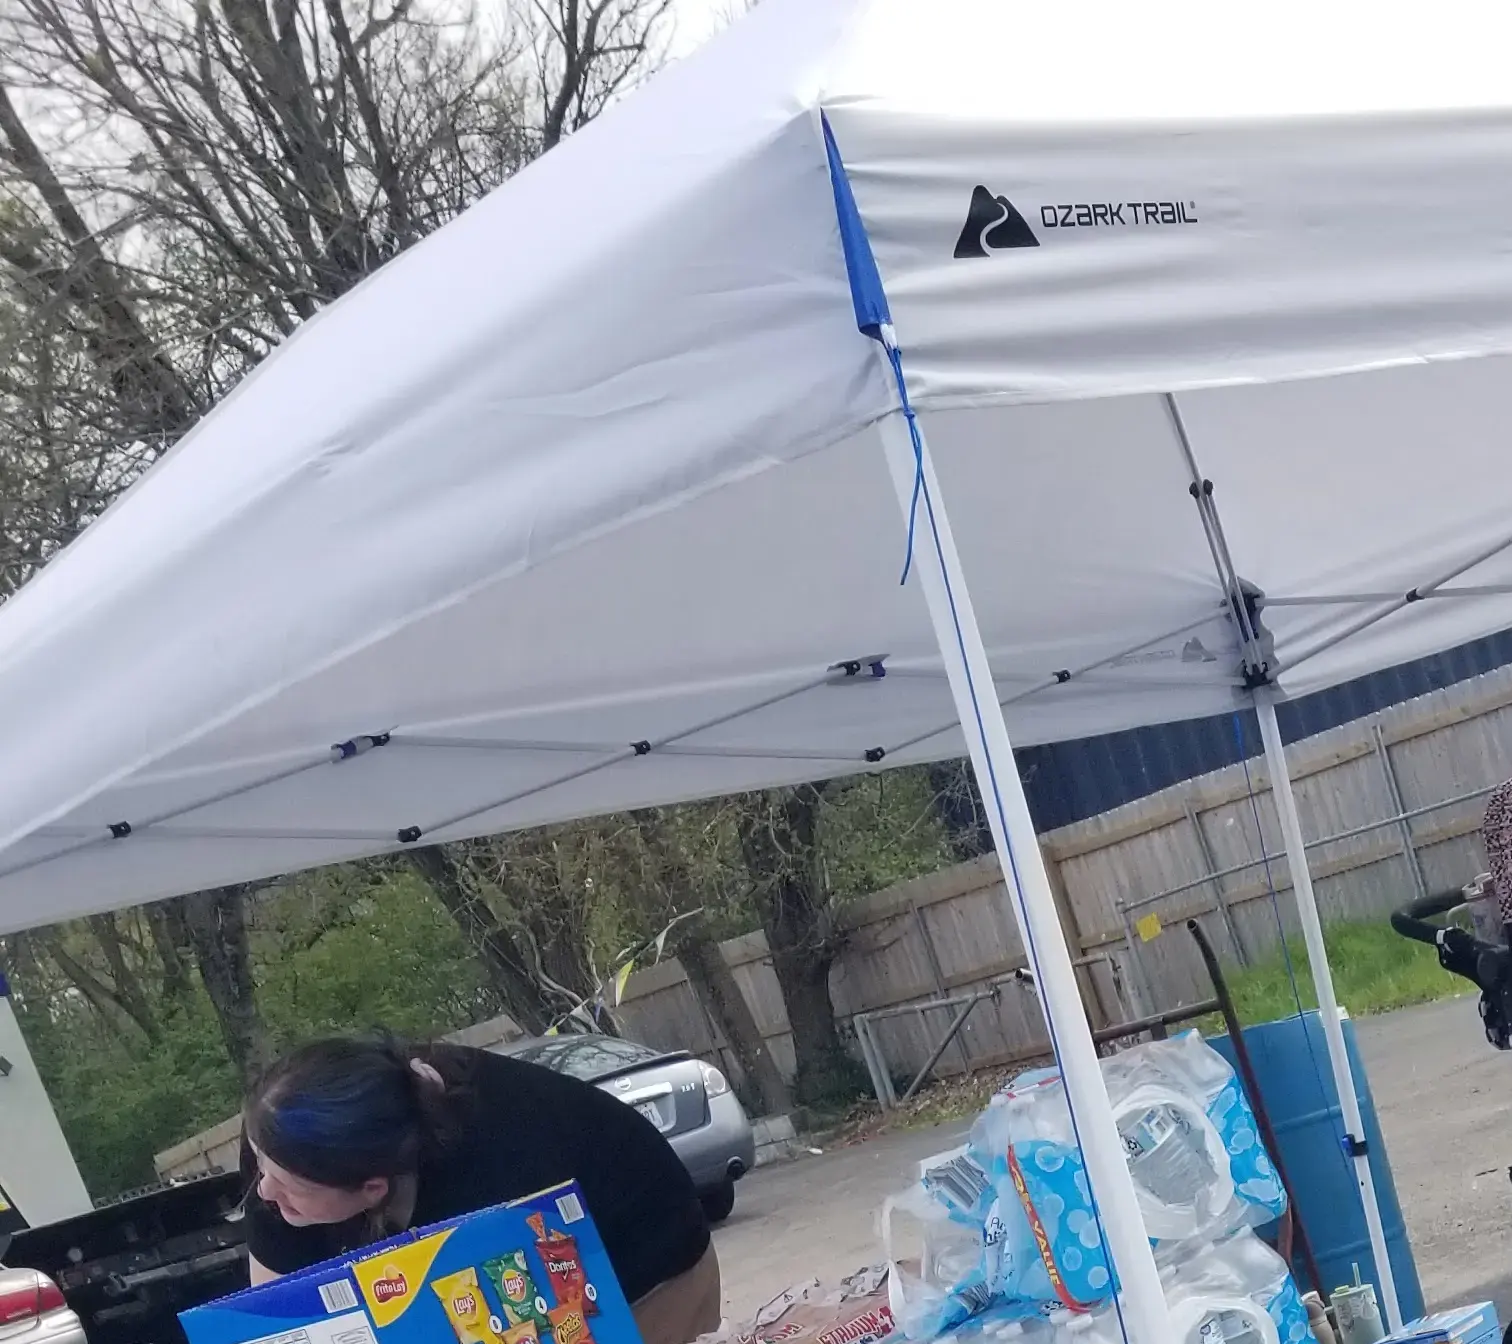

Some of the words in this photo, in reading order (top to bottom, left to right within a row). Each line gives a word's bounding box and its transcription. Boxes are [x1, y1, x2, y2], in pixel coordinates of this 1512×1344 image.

[1040, 202, 1126, 228] OZARK
[1127, 200, 1198, 225] TRAIL
[549, 1259, 577, 1274] Doritos
[503, 1274, 525, 1296] Lay's
[454, 1295, 476, 1315] Lay's
